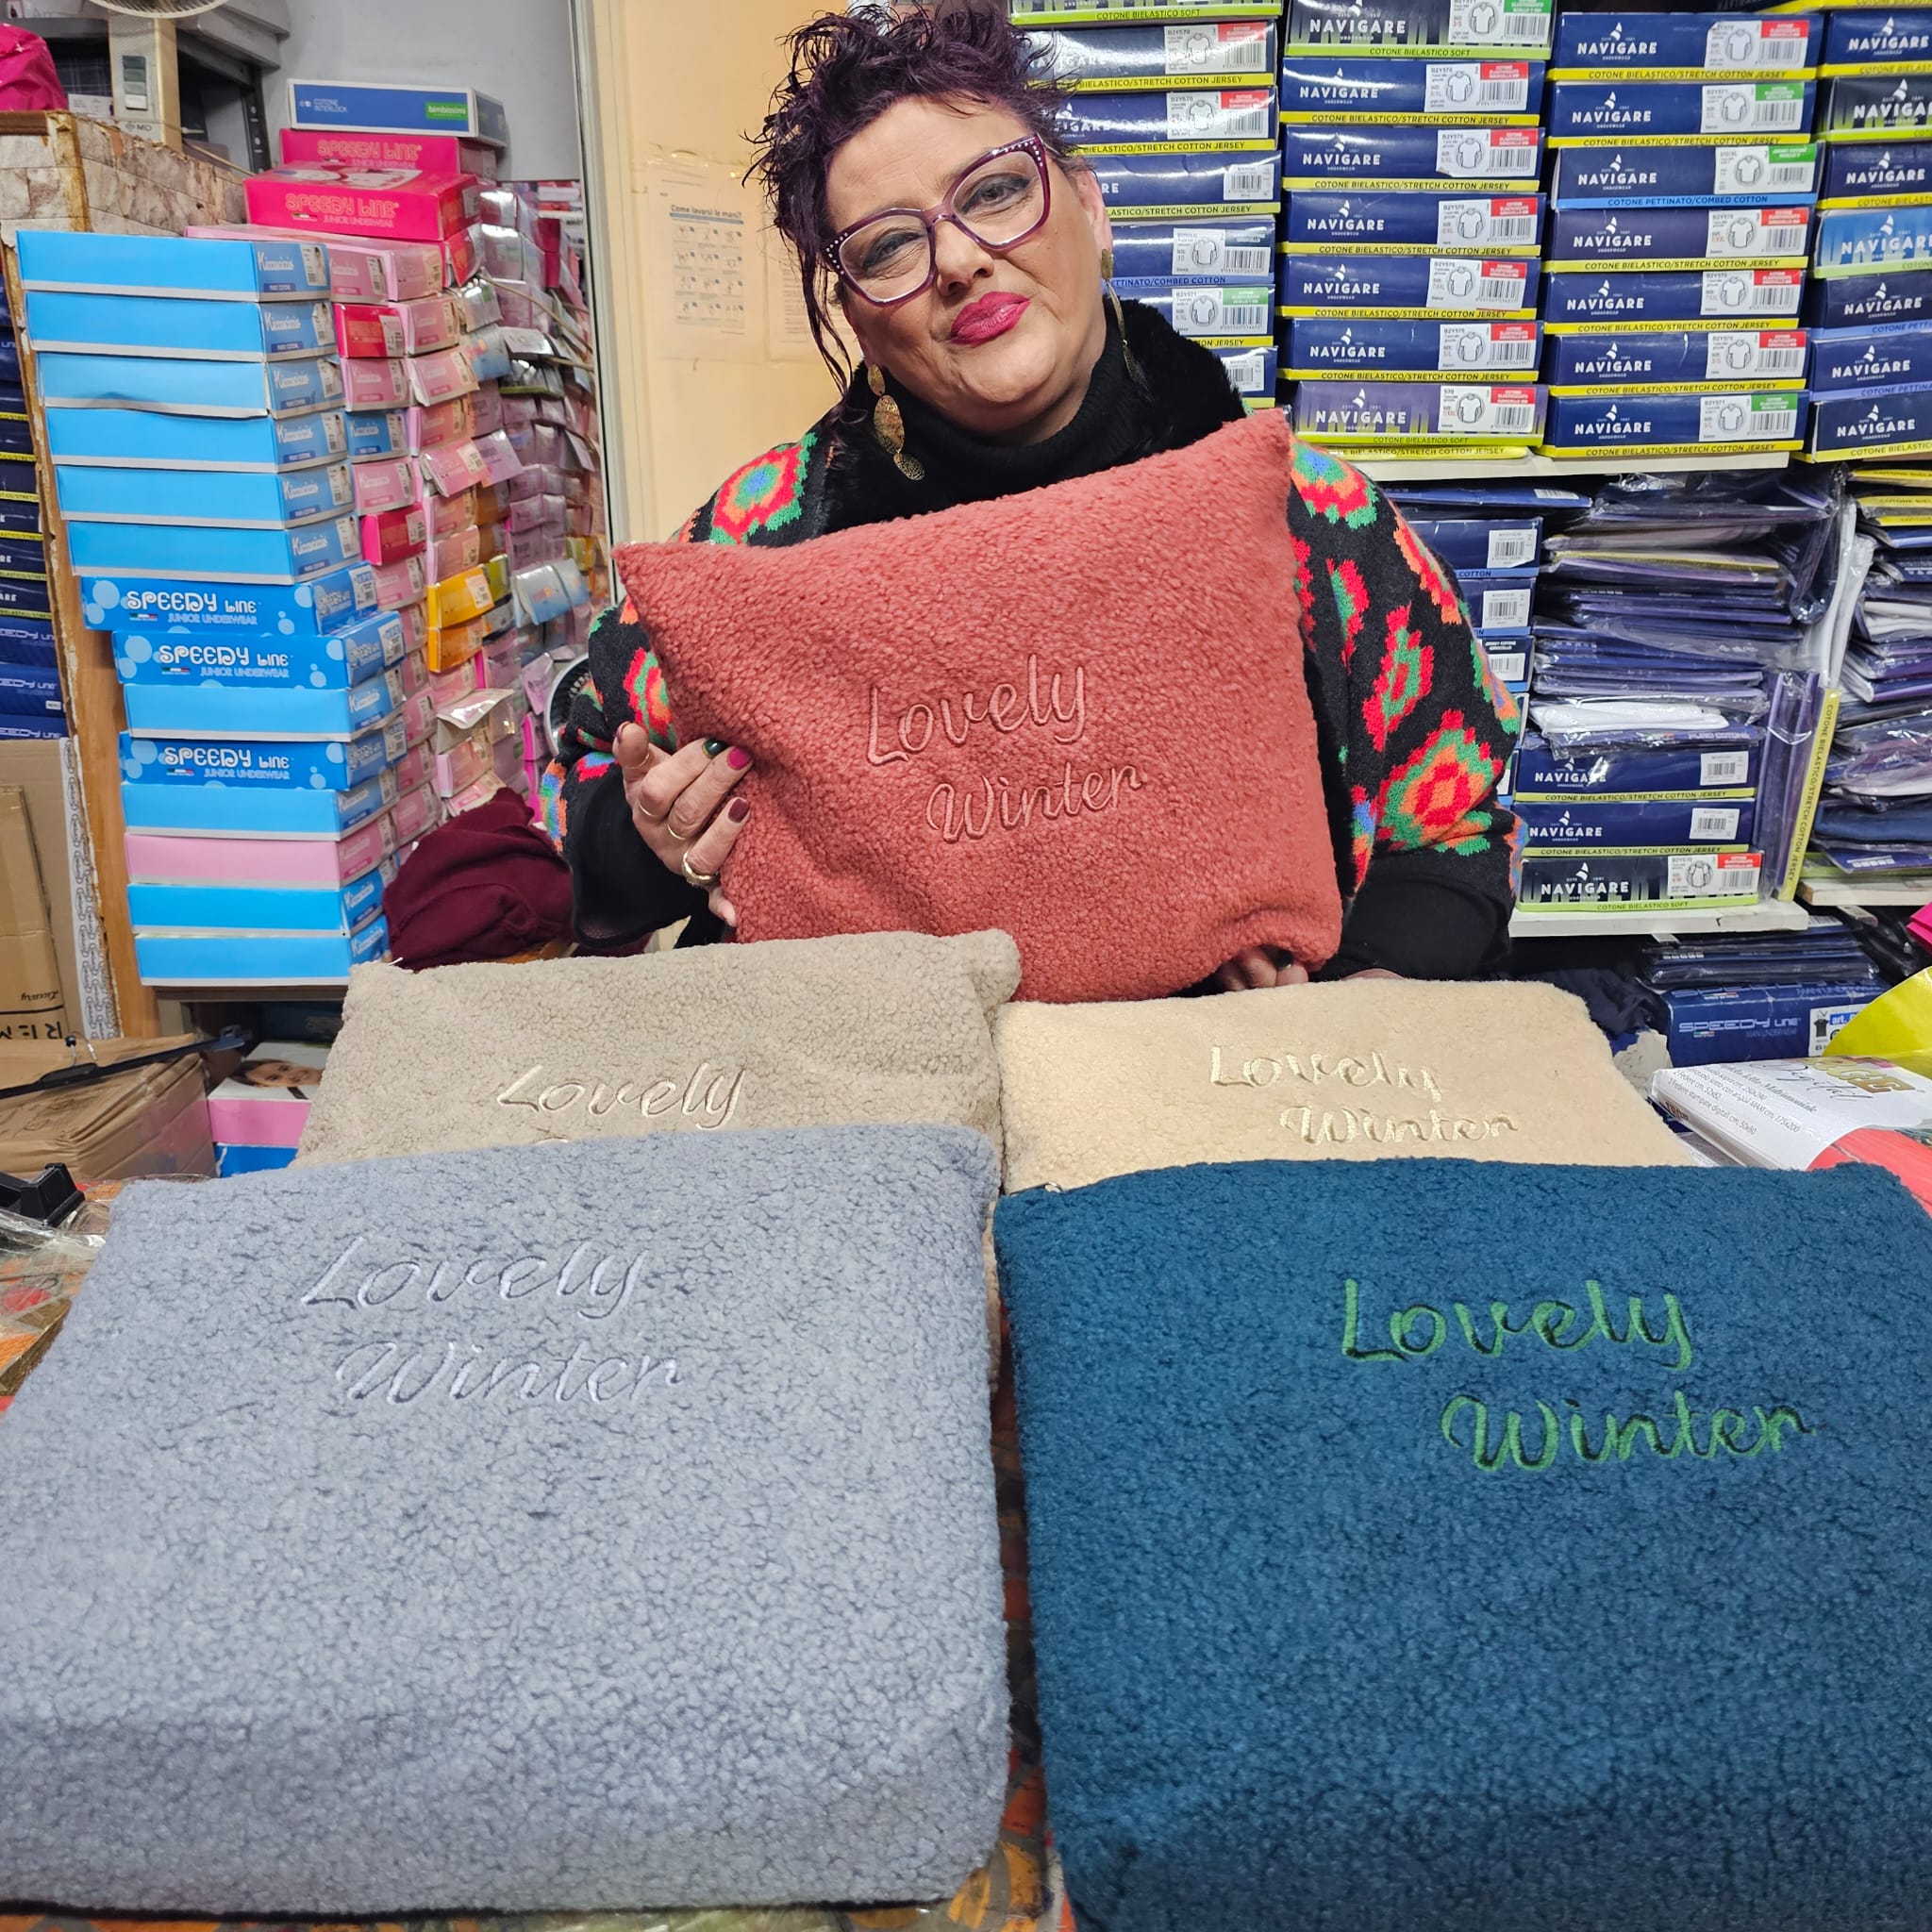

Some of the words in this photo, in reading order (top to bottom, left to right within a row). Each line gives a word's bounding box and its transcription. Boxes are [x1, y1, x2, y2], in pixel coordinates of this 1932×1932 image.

[1309, 19, 1406, 35] NAVIGARE
[1577, 42, 1657, 55] NAVIGARE
[1849, 37, 1929, 51] NAVIGARE
[1407, 48, 1448, 57] BIELASTICO
[1299, 87, 1378, 99] NAVIGARE
[1312, 114, 1347, 123] COTONE
[1441, 116, 1475, 125] COTTON
[1572, 111, 1651, 123] NAVIGARE
[1303, 154, 1381, 165] NAVIGARE
[1578, 173, 1657, 185] NAVIGARE
[1846, 169, 1925, 184] NAVIGARE
[1315, 180, 1349, 189] COTONE
[1479, 181, 1509, 190] JERSEY
[285, 193, 356, 216] SPEEDY
[1185, 207, 1219, 215] COTTON
[1307, 219, 1385, 230] NAVIGARE
[1574, 236, 1652, 247] NAVIGARE
[1303, 283, 1380, 294] NAVIGARE
[1567, 298, 1644, 310] NAVIGARE
[1844, 297, 1923, 315] NAVIGARE
[1309, 346, 1385, 358] NAVIGARE
[1575, 360, 1651, 373] NAVIGARE
[1832, 360, 1910, 377] NAVIGARE
[1316, 411, 1407, 424] NAVIGARE
[1574, 423, 1651, 434] NAVIGARE
[1837, 420, 1915, 437] NAVIGARE
[126, 591, 217, 612] SPEEDY
[225, 600, 257, 613] LINE
[158, 645, 250, 666] SPEEDY
[257, 653, 289, 666] LINE
[867, 653, 1087, 767] Lovely
[164, 746, 251, 766] SPEEDY
[258, 756, 290, 769] LINE
[1534, 773, 1607, 783] NAVIGAE
[924, 760, 1143, 844] Winter
[1529, 826, 1602, 837] NAVIGARE
[1541, 882, 1629, 894] NAVIGARE
[1679, 1018, 1770, 1032] SPEEDY
[1774, 1018, 1798, 1027] LINE
[1209, 1045, 1442, 1102] Lovely
[496, 1062, 746, 1130] Lovely
[1279, 1104, 1518, 1144] Winter
[300, 1237, 649, 1320] Lovely
[1341, 1277, 1693, 1371] Lovely
[335, 1339, 687, 1405] Winter
[1440, 1389, 1822, 1473] Winter
